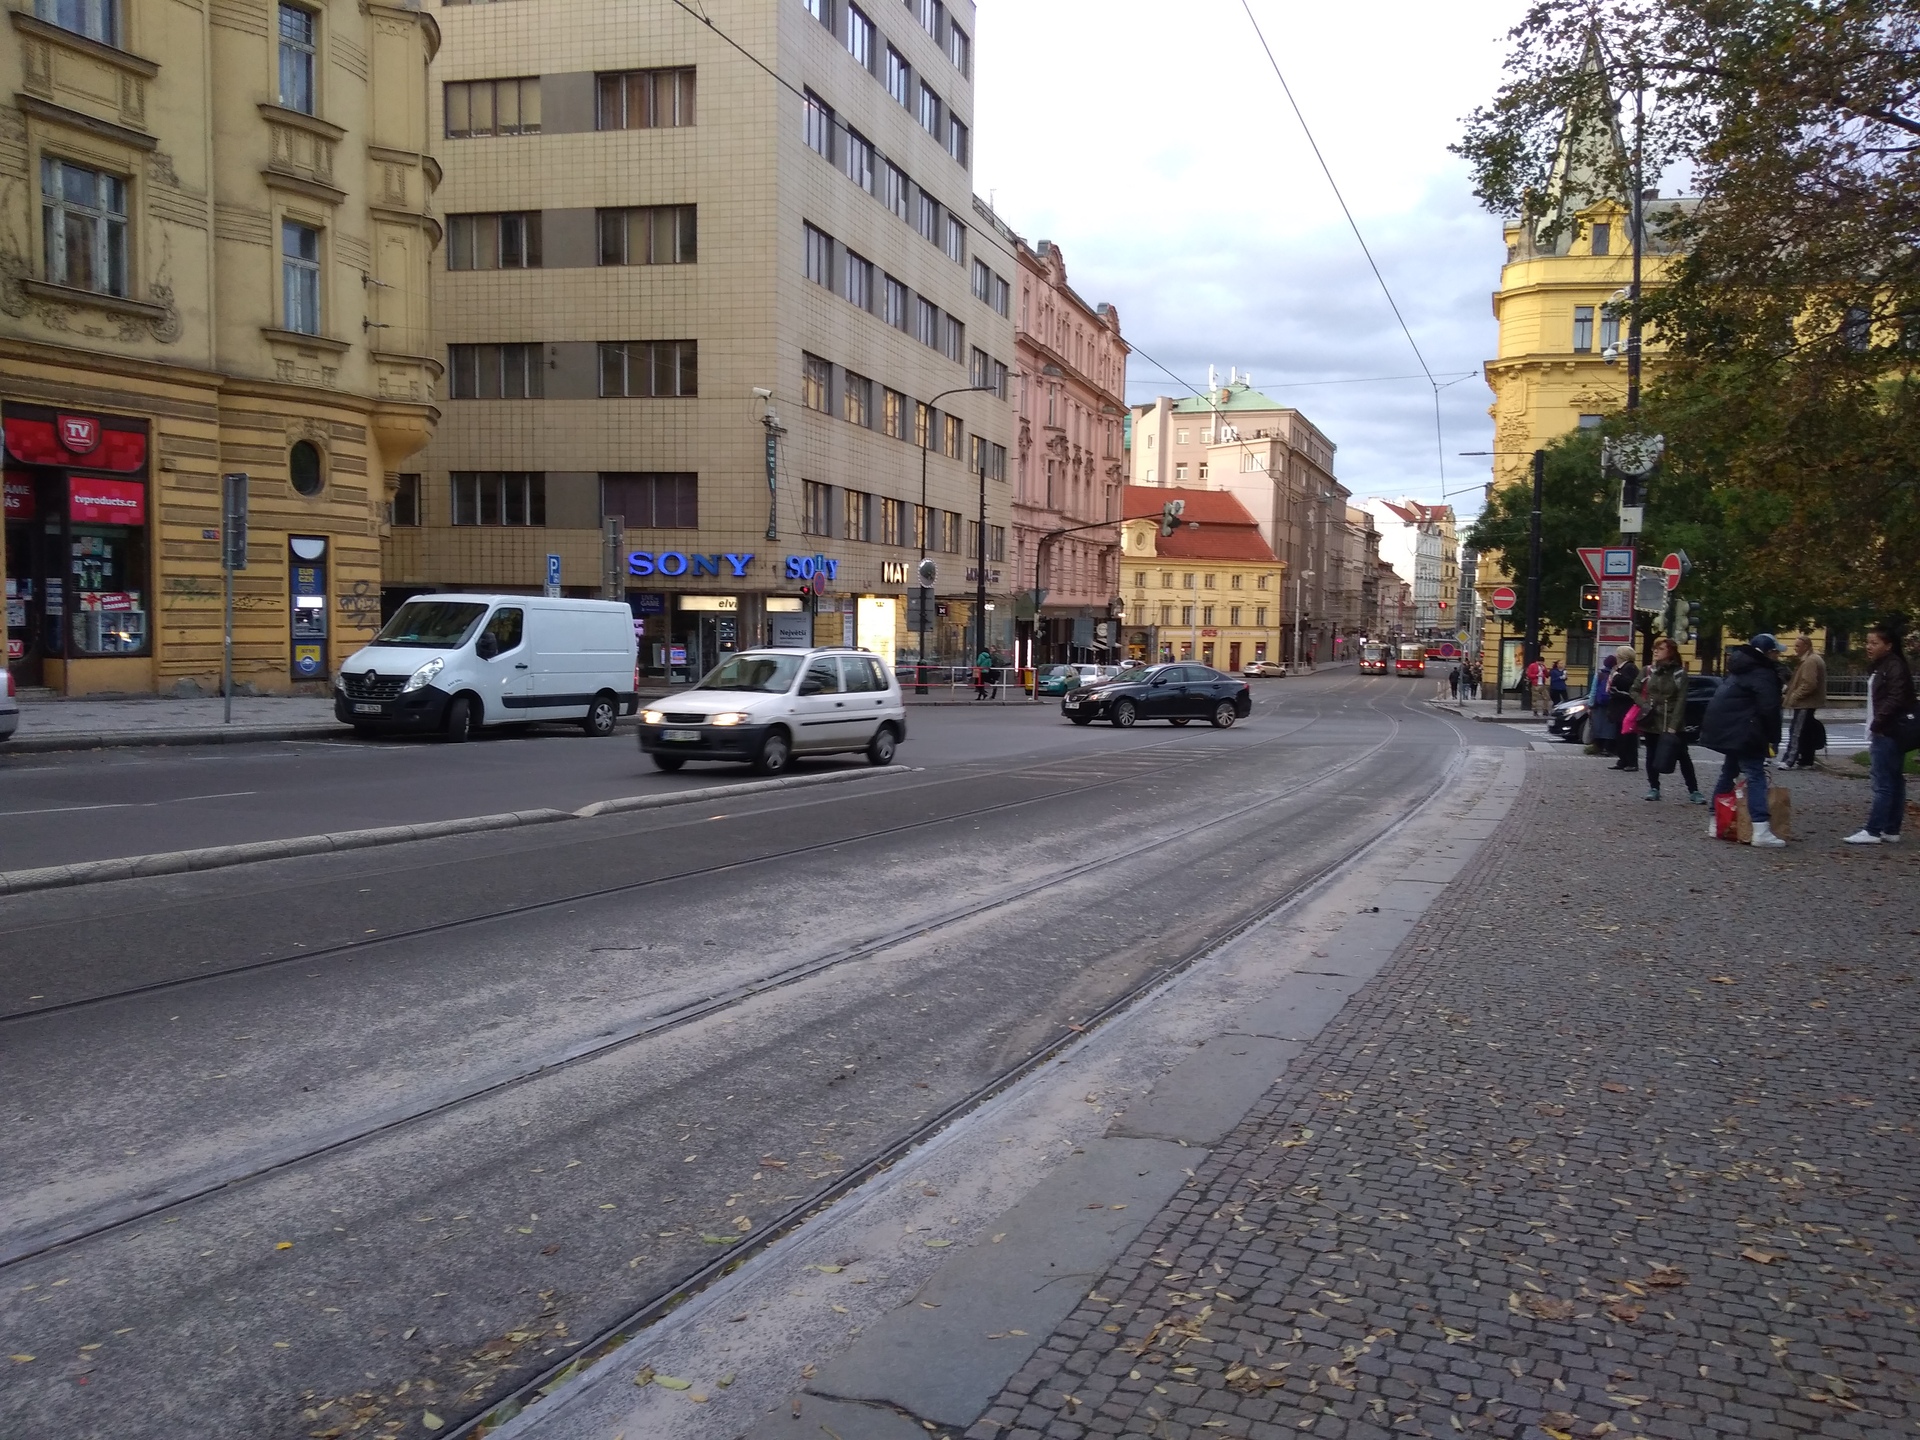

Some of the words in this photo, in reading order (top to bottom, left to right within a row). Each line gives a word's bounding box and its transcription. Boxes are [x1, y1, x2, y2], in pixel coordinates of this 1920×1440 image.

[67, 424, 89, 437] TV
[74, 495, 137, 507] tvproducts.cz
[550, 558, 558, 576] P
[628, 551, 755, 577] SONY
[785, 555, 839, 580] SOY
[881, 561, 909, 583] MAT
[780, 628, 807, 637] Největší
